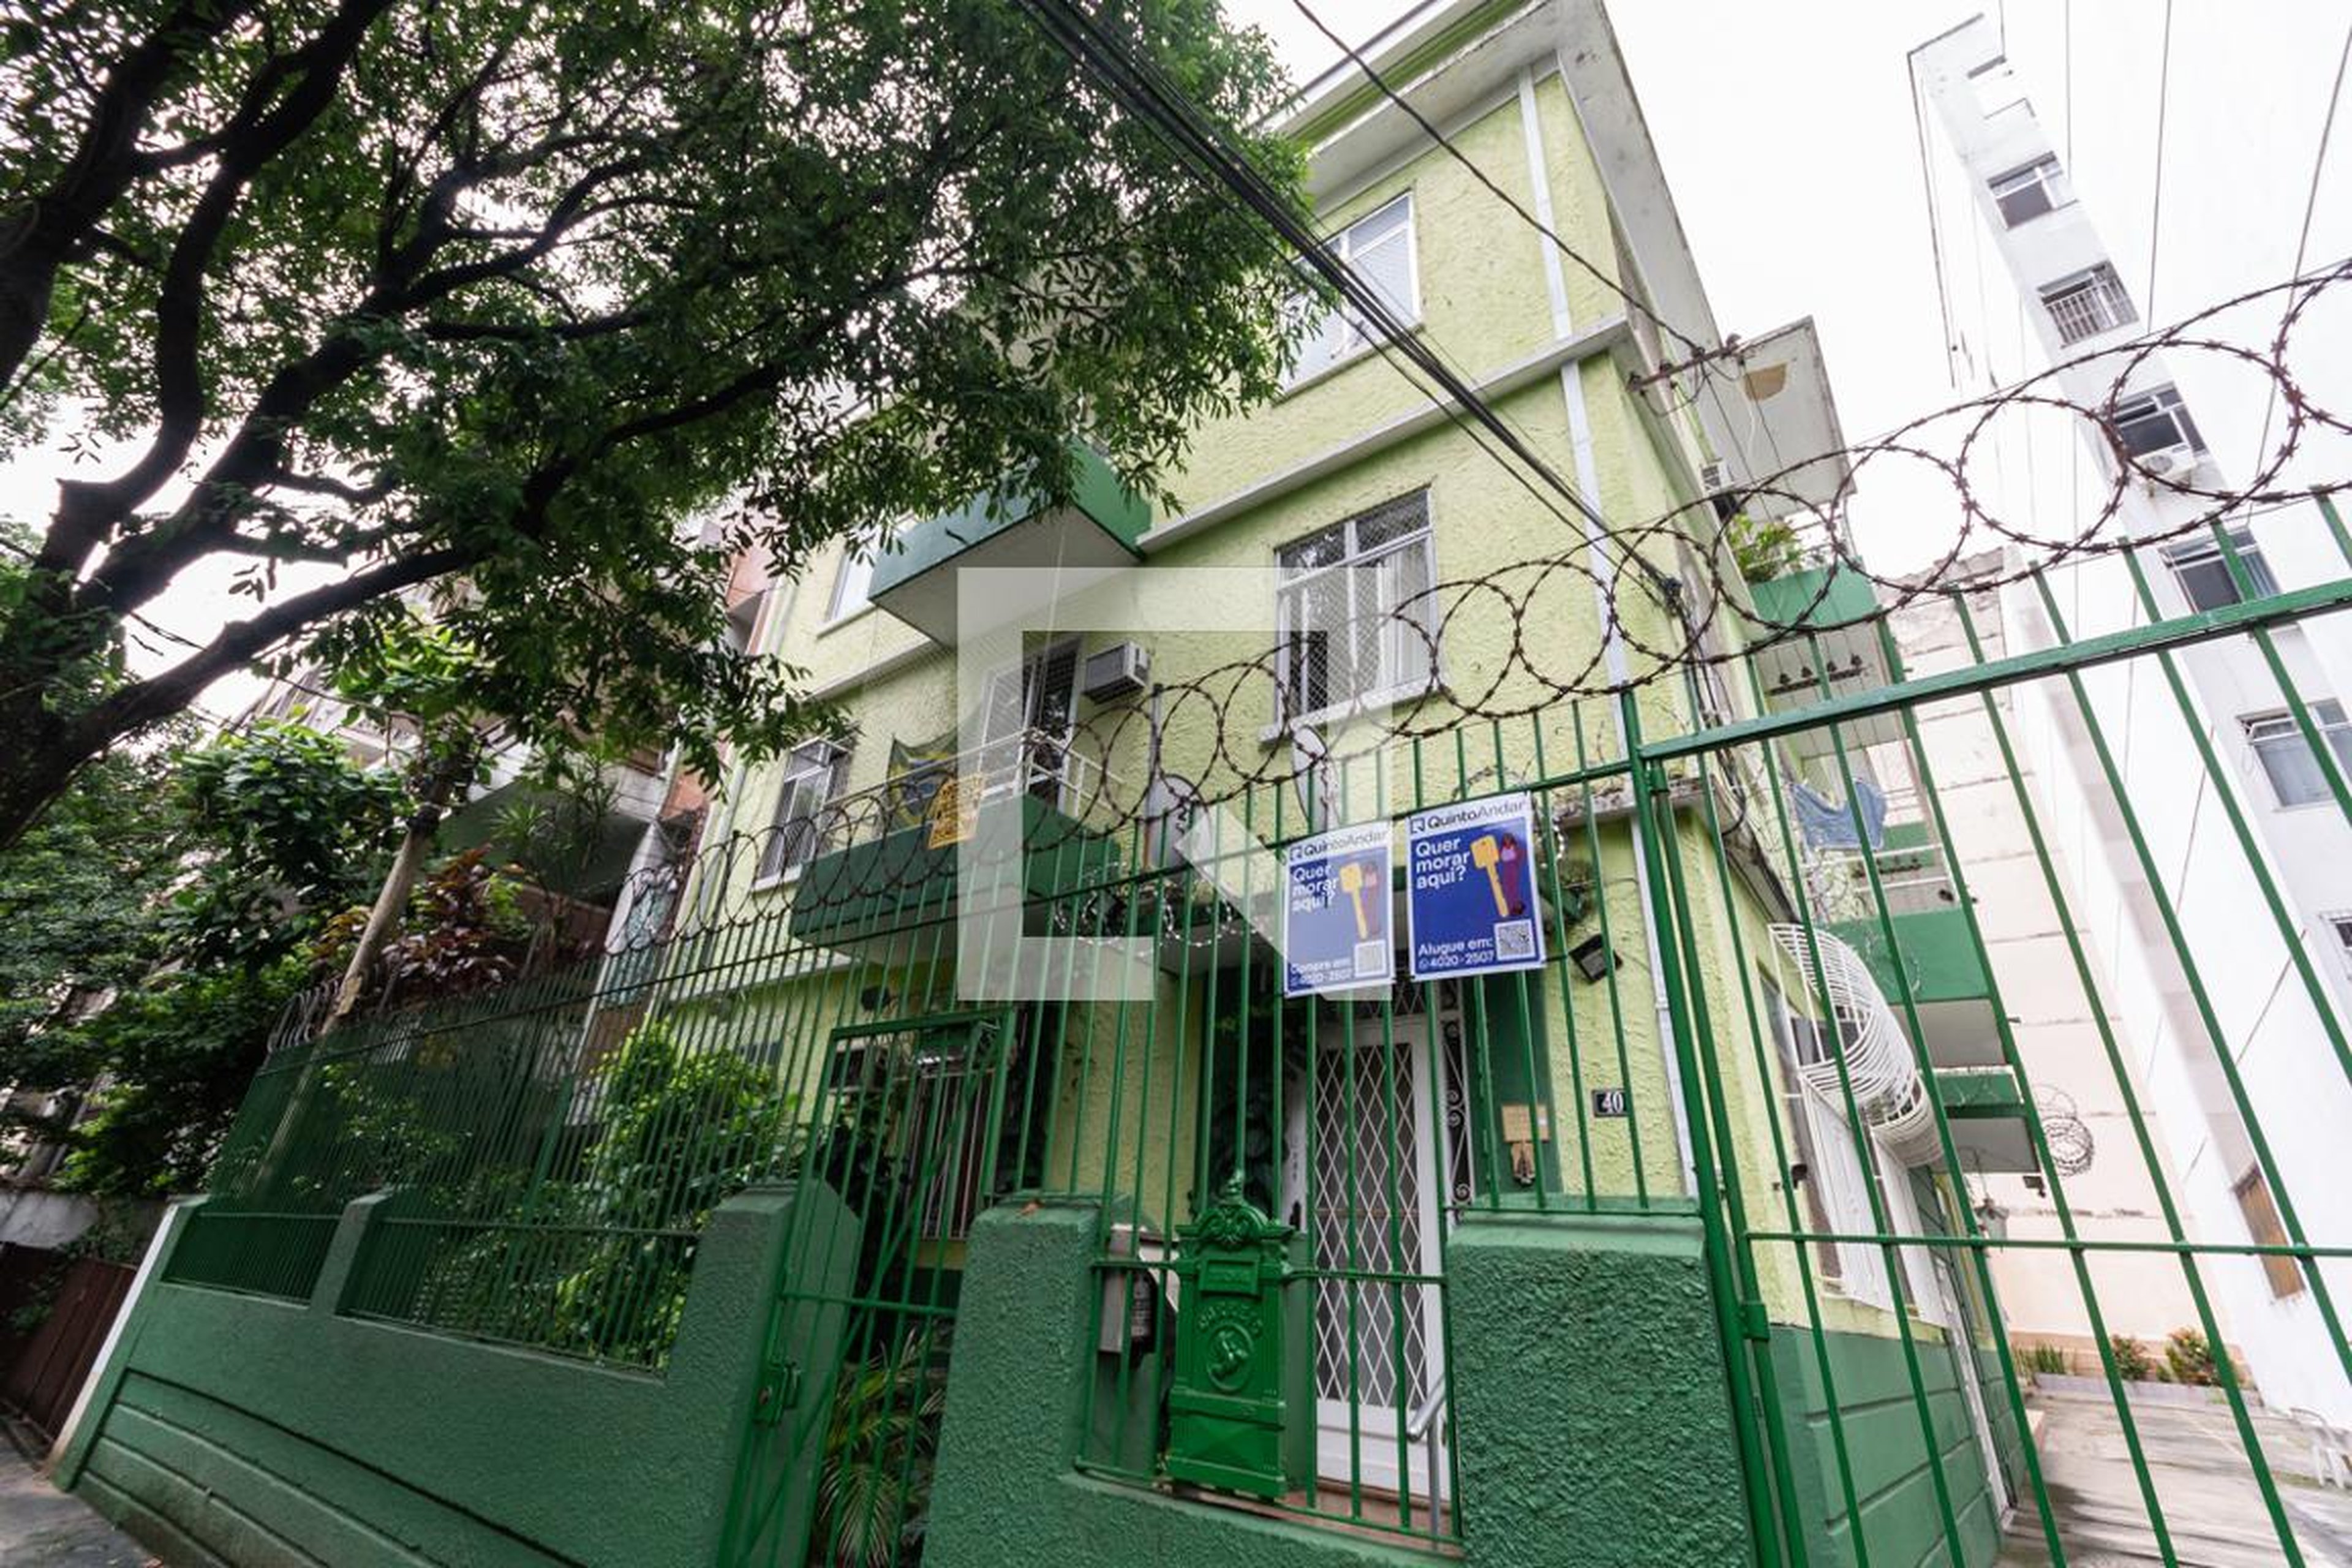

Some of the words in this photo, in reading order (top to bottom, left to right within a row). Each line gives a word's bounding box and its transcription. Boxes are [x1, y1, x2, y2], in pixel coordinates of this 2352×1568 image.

[1427, 800, 1523, 828] QuintoAndar
[1416, 838, 1461, 857] Quer
[1417, 851, 1470, 873] morar
[1294, 865, 1332, 882] Quer
[1417, 865, 1466, 889] aqui?
[1292, 878, 1339, 896] morar
[1292, 890, 1336, 913] aqui?
[1418, 942, 1464, 957] Alugue
[1468, 937, 1493, 950] em:
[1602, 1091, 1624, 1114] 40
